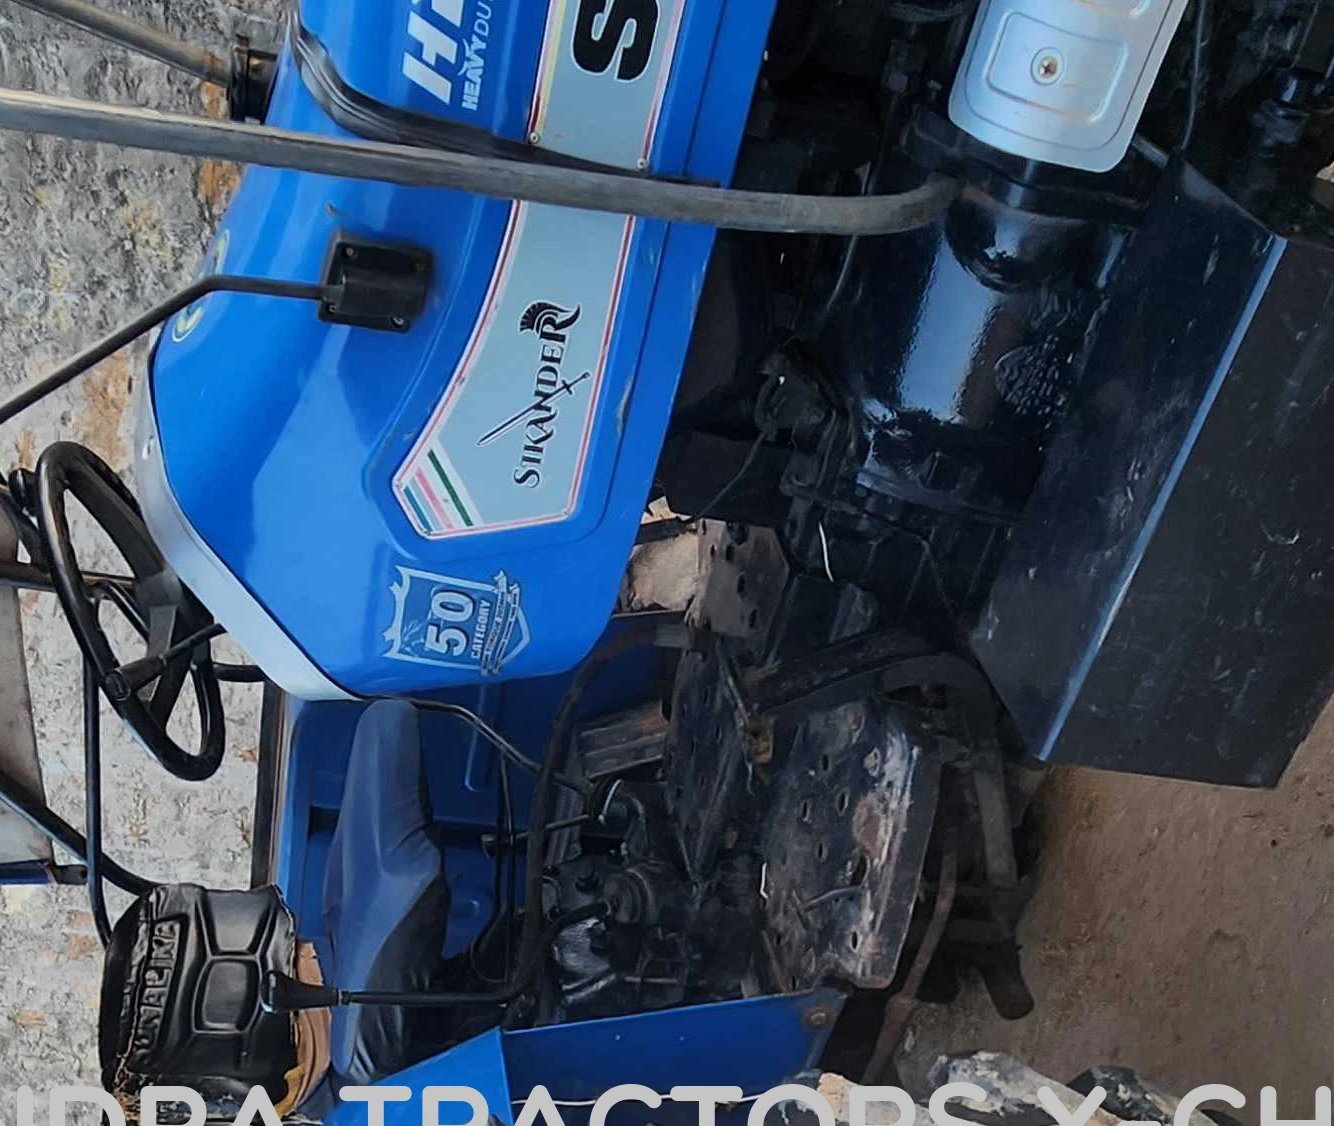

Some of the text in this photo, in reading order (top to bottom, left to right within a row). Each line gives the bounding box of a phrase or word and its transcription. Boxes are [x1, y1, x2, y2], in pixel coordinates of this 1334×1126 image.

[473, 0, 494, 36] DU
[571, 0, 659, 82] S
[513, 302, 581, 489] SIKANDER
[424, 591, 474, 657] 50
[471, 600, 492, 659] CATEGORY
